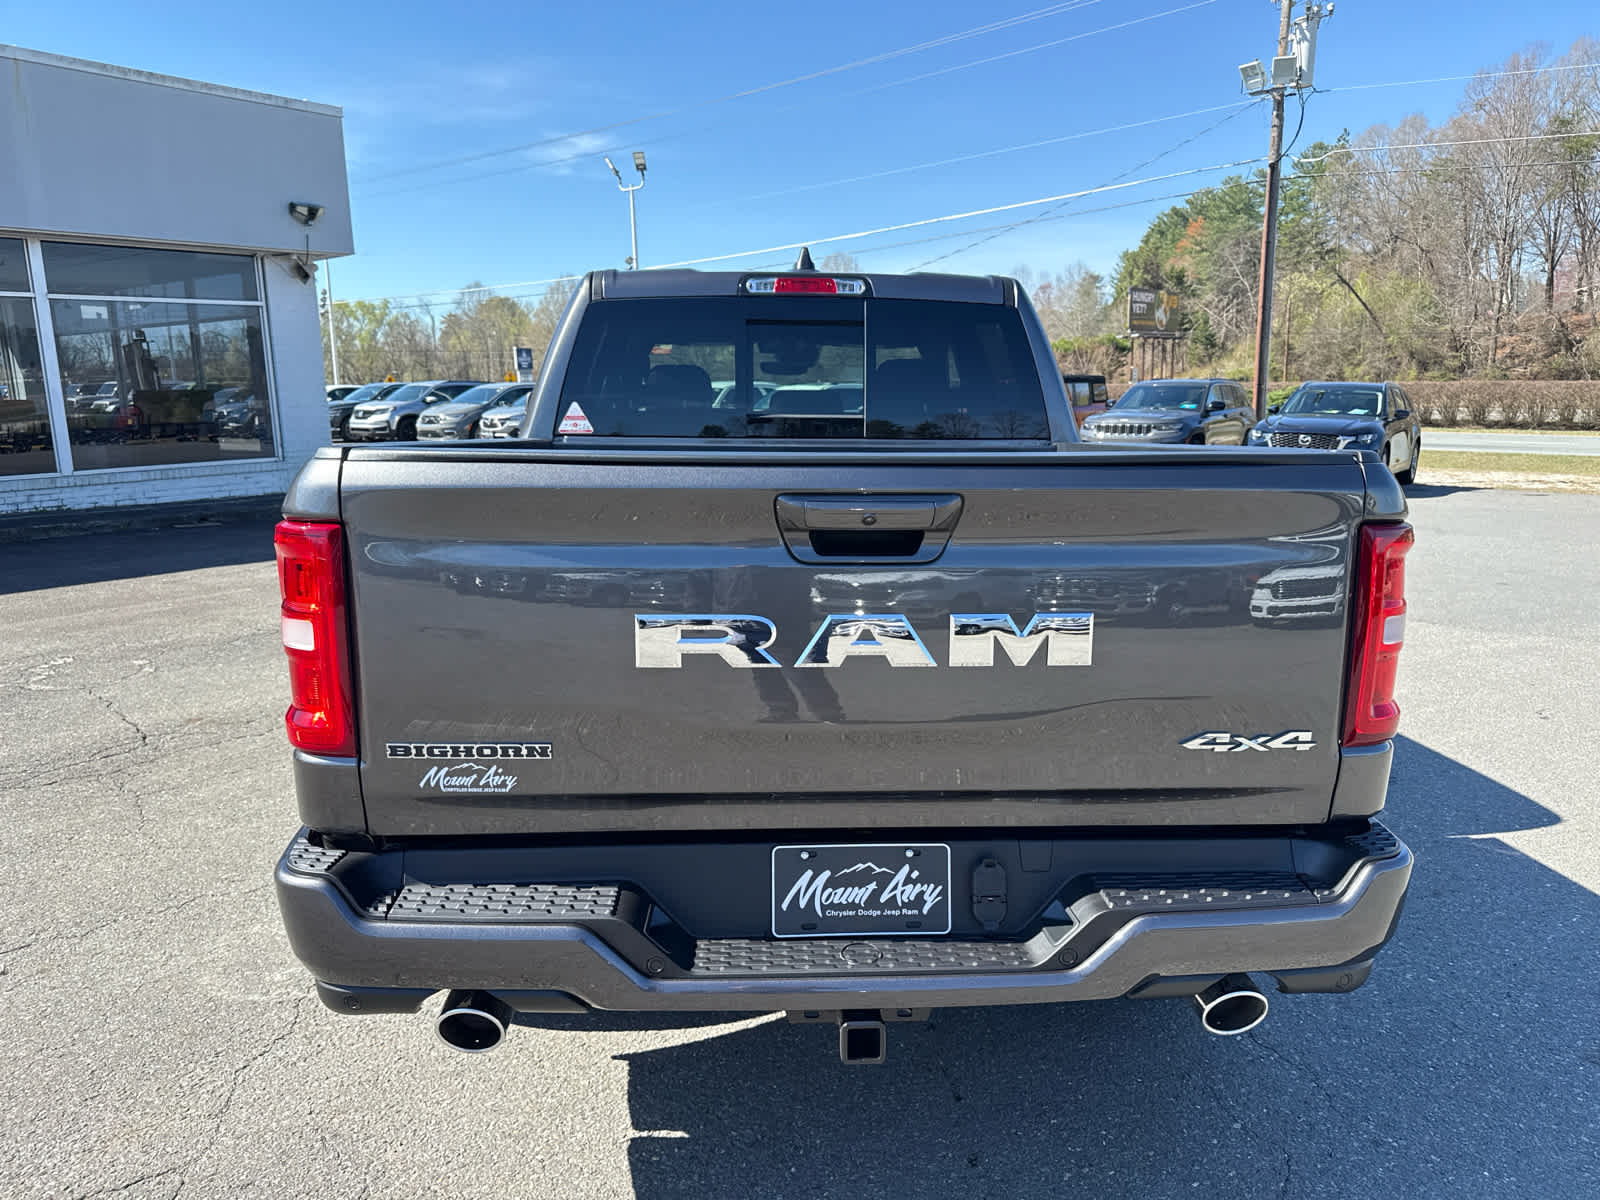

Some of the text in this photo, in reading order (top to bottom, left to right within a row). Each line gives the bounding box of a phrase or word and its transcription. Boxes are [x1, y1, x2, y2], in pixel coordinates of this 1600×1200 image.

[634, 613, 1095, 668] RAM
[386, 743, 552, 759] BIGHORN
[1181, 730, 1317, 752] 4x4
[419, 765, 518, 792] Mount Airy
[781, 864, 943, 918] Mount Airy
[826, 908, 919, 917] Chrysler Dodge Jeep Ram
